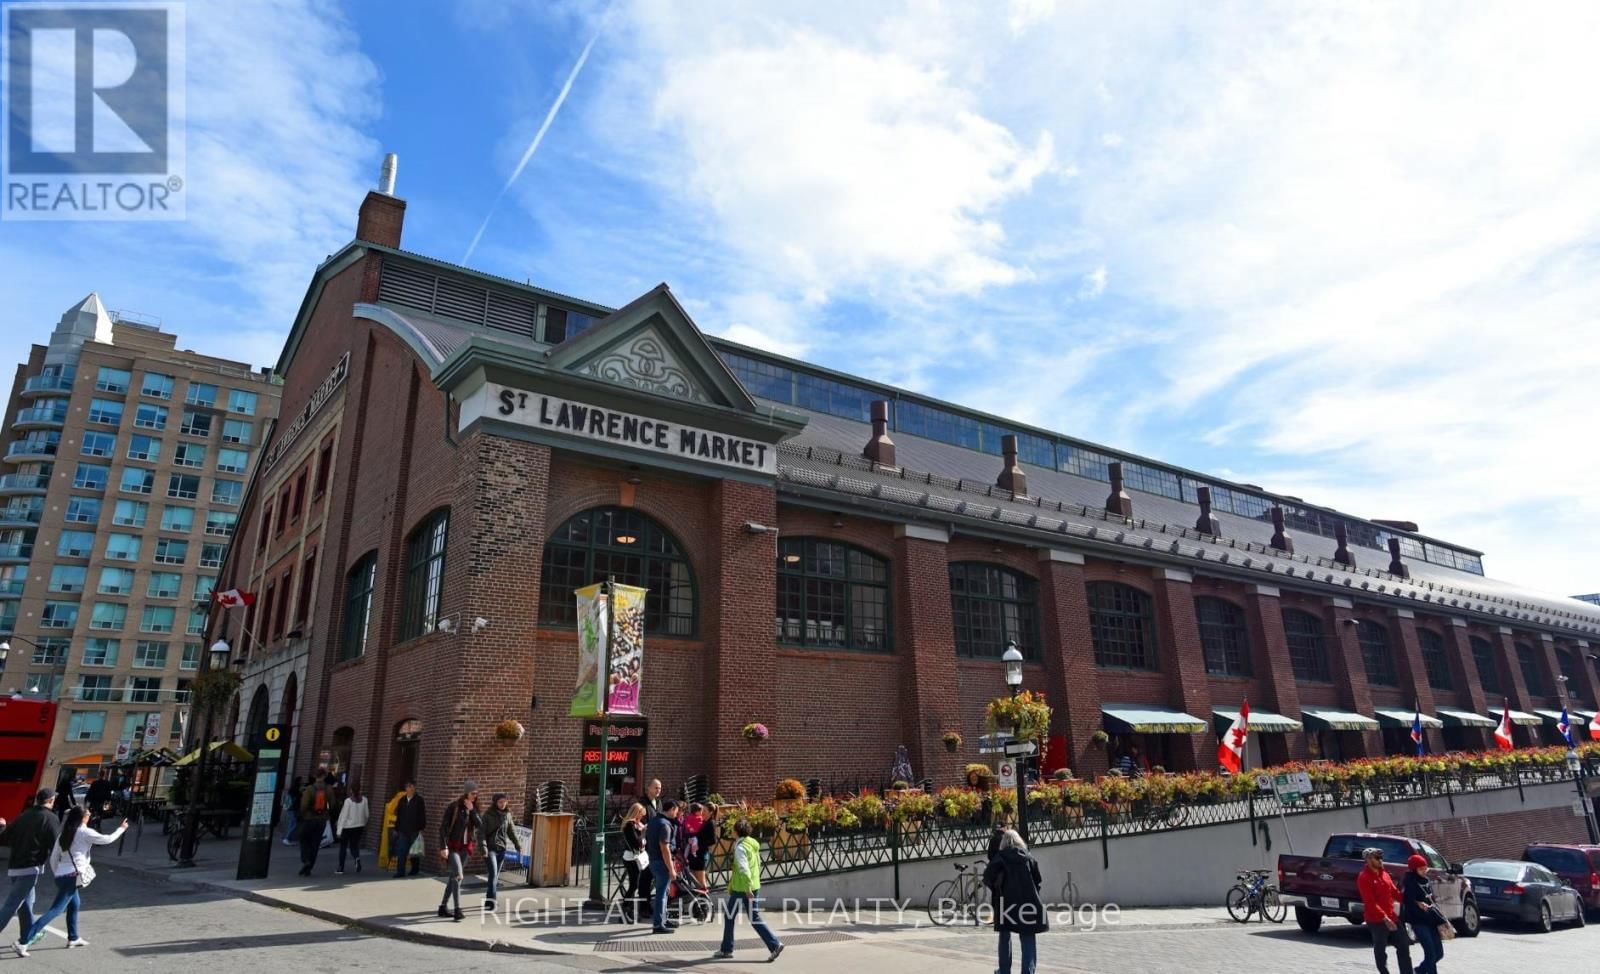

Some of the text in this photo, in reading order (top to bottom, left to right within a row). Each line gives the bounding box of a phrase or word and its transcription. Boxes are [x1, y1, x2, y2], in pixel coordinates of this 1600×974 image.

[540, 397, 669, 449] LAWRENCE
[680, 429, 768, 468] MARKET
[584, 750, 629, 761] RESTURANT
[584, 763, 600, 774] OPE
